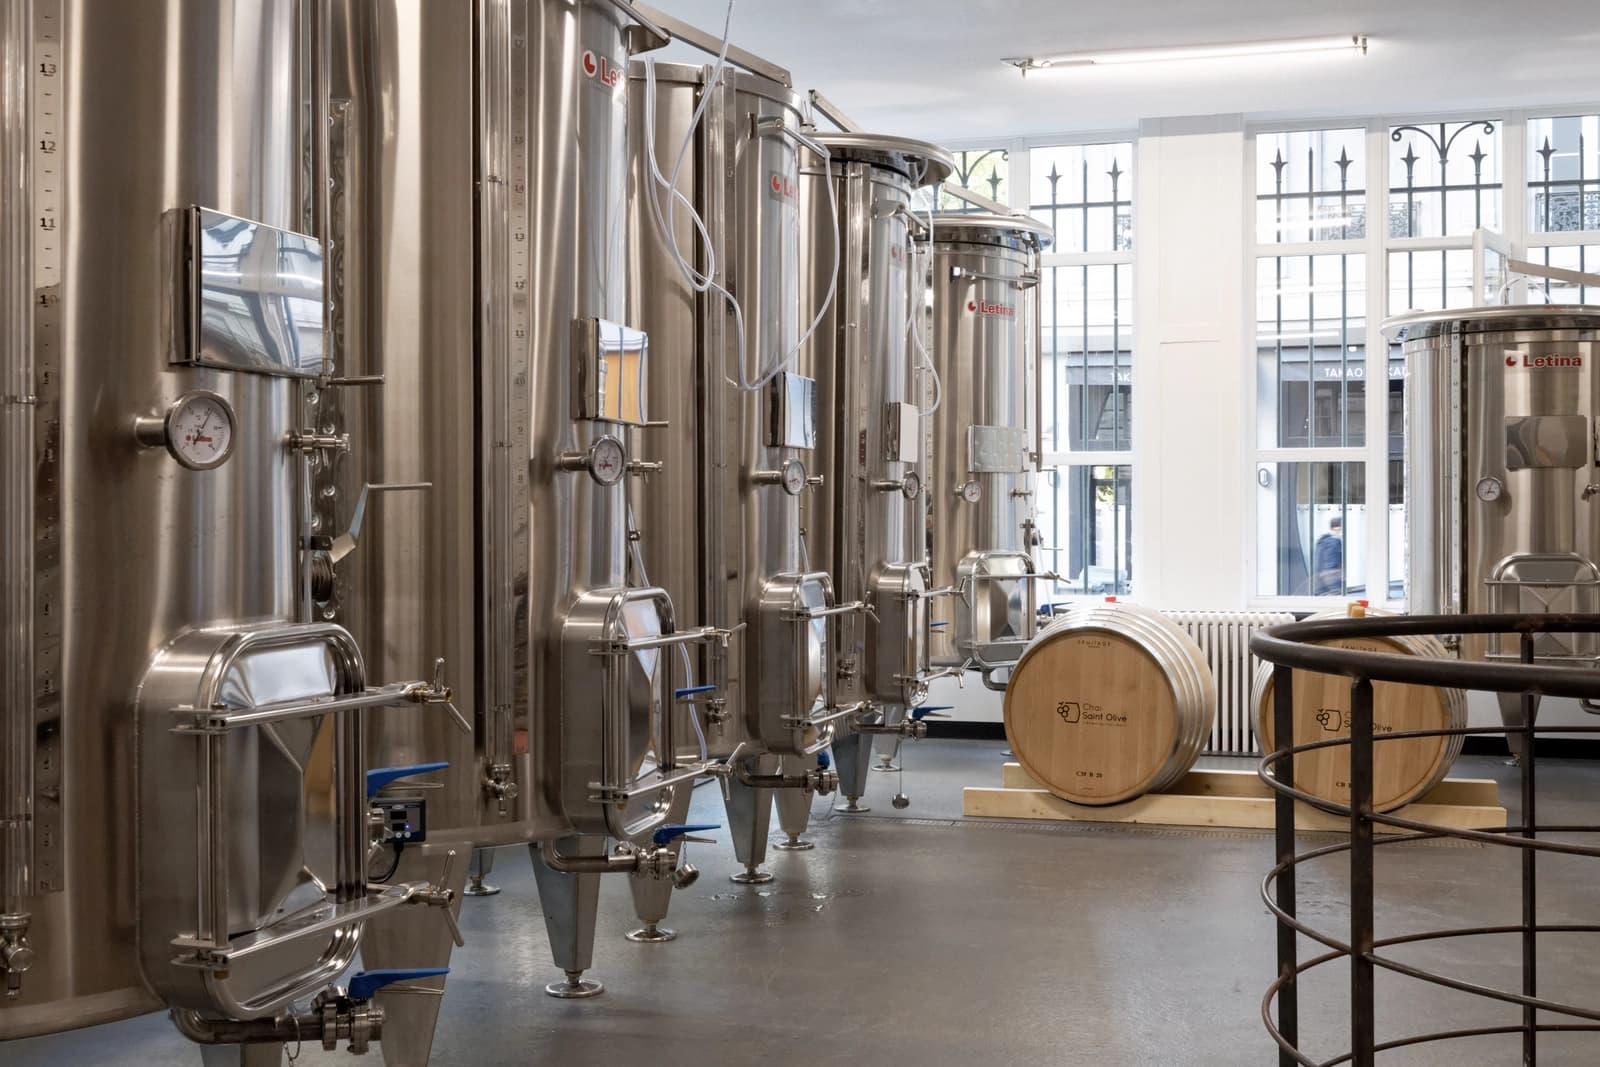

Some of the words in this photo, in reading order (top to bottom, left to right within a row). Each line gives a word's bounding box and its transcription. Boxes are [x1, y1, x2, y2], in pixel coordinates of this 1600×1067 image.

[40, 63, 57, 74] 13
[40, 140, 57, 151] 12
[40, 217, 57, 228] 11
[1523, 354, 1582, 368] Letina
[1082, 711, 1104, 721] Saint
[1106, 713, 1128, 723] Olive
